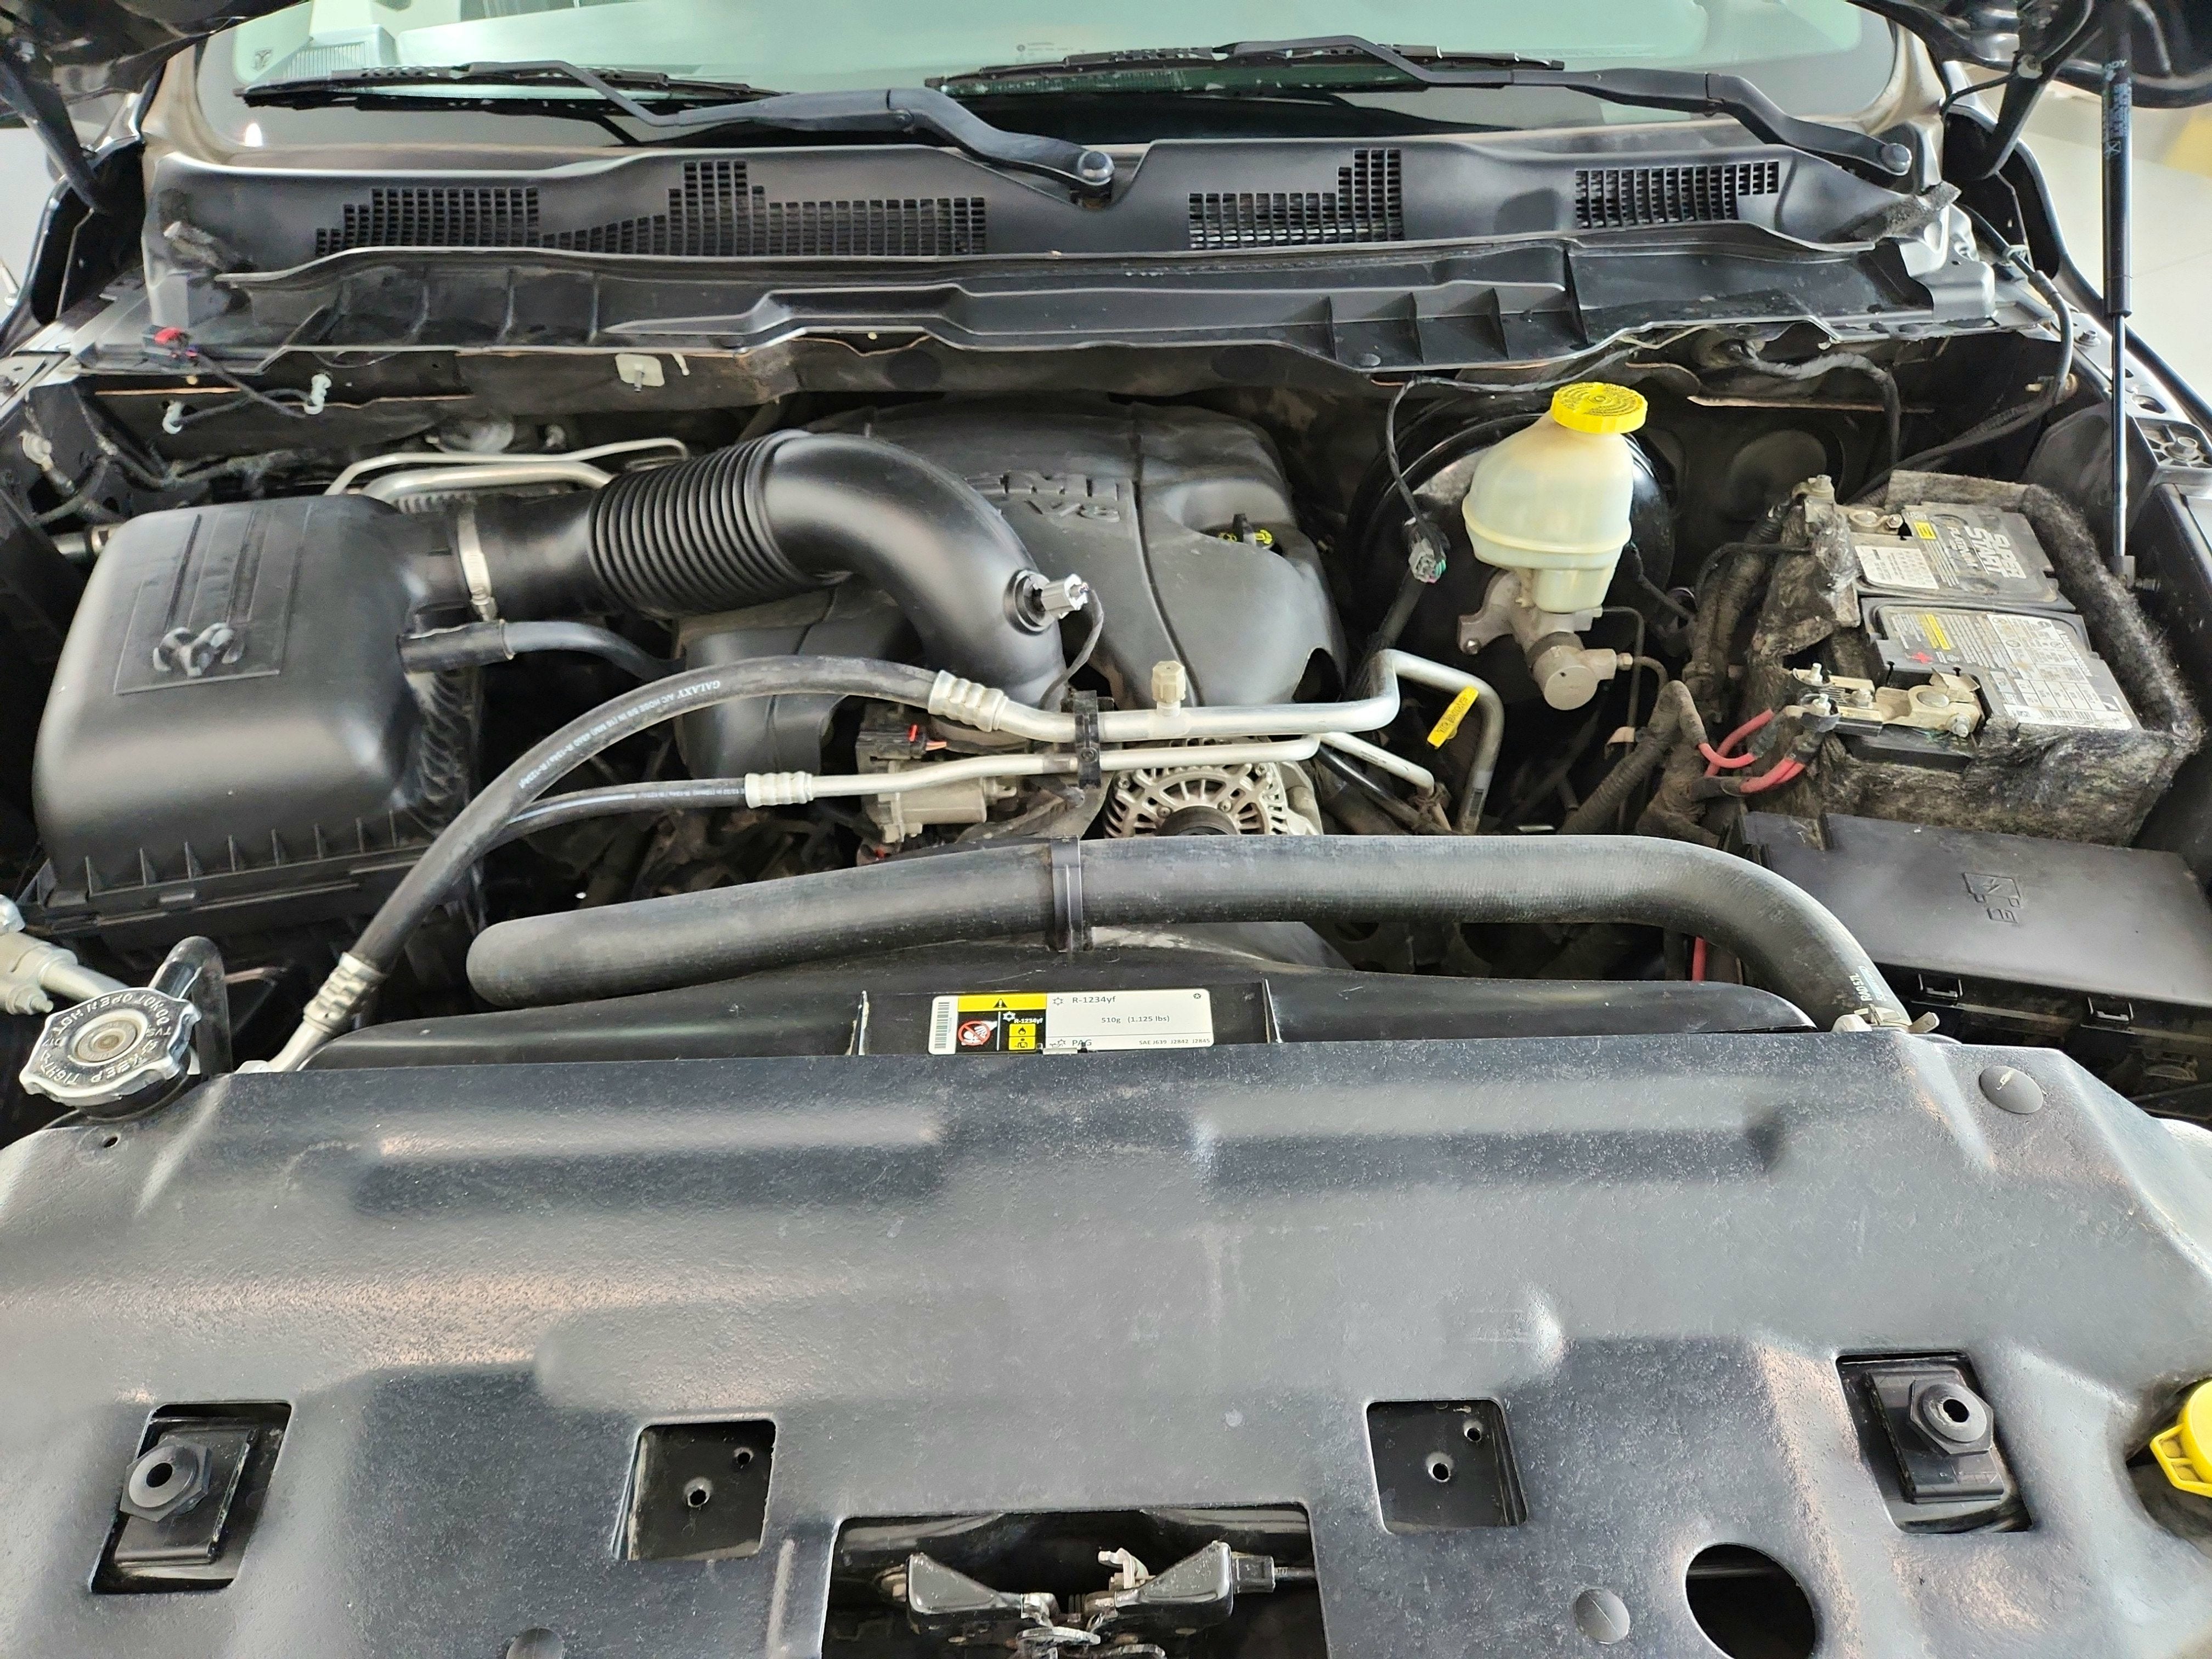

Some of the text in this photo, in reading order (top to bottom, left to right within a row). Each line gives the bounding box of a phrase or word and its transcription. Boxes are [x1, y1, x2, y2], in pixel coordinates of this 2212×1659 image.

[1964, 526, 2010, 578] START
[1994, 533, 2027, 579] SUPER
[676, 680, 721, 699] GALAXY
[638, 698, 661, 713] HOSE
[1436, 722, 1449, 733] OIL
[1072, 996, 1116, 1004] R-1234yf
[1855, 986, 1873, 1001] RAD
[52, 992, 170, 1036] DO NOT OPEN HOT
[40, 1053, 143, 1085] KEEP TIGHT
